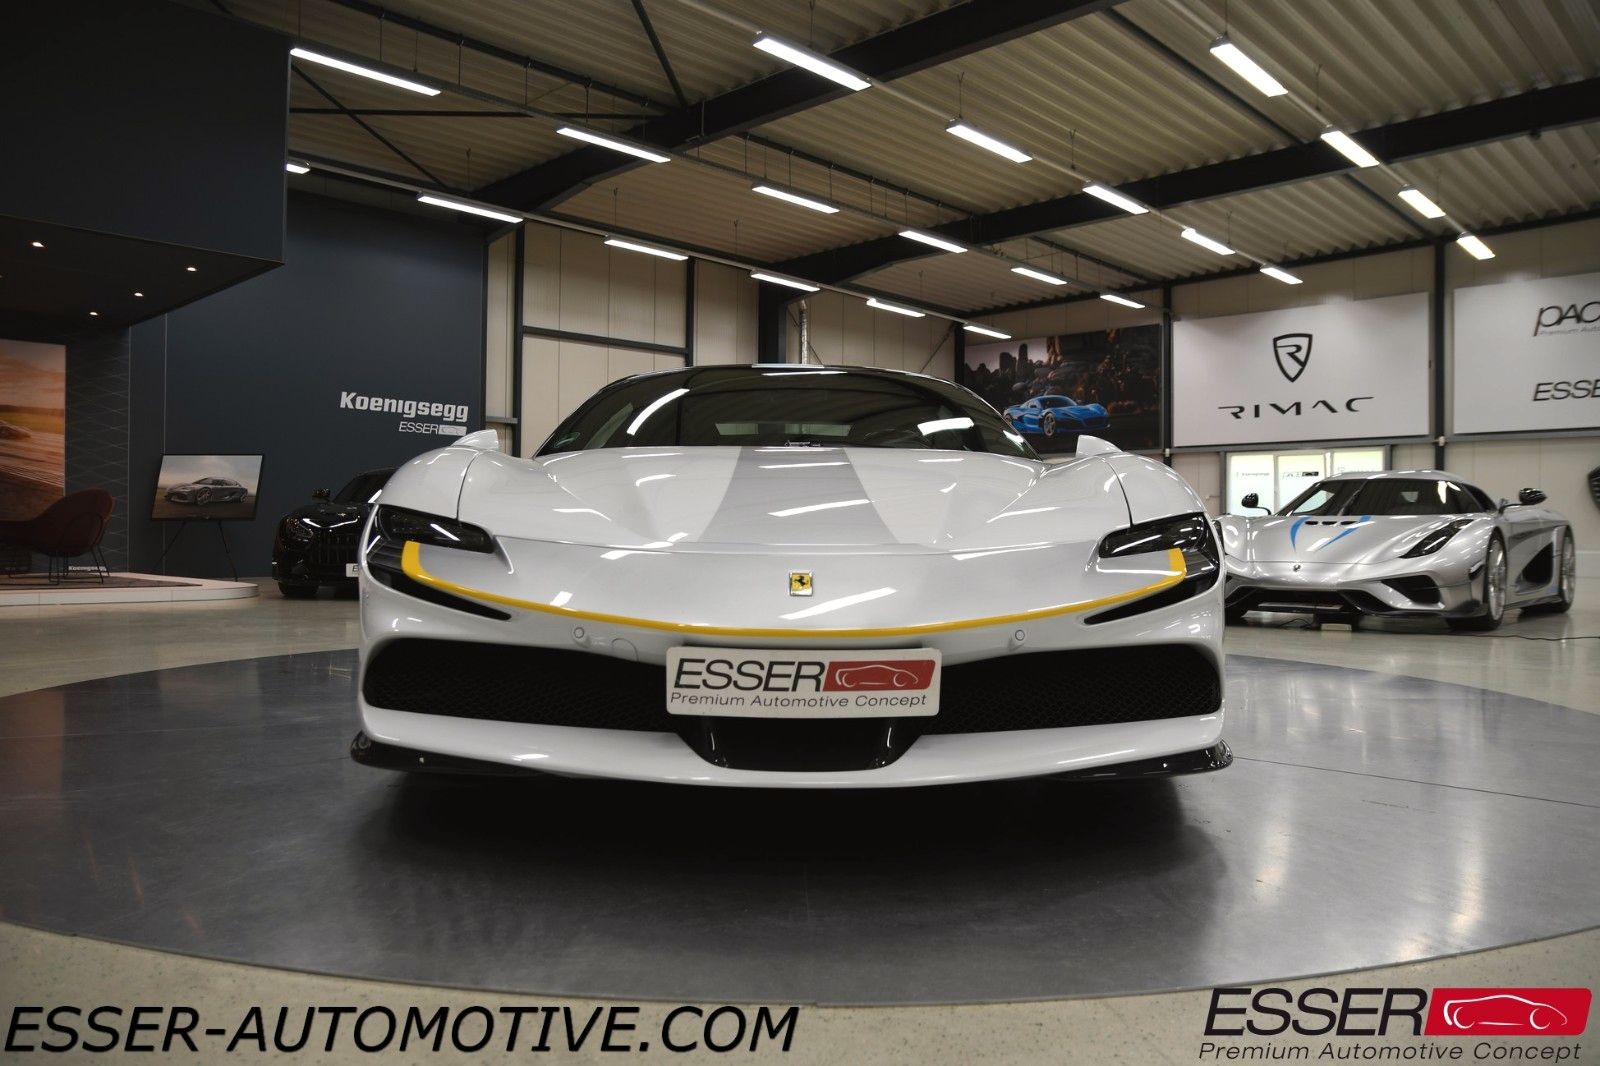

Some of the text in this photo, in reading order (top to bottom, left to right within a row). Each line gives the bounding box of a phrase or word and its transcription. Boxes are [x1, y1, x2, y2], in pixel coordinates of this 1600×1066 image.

[340, 391, 469, 422] Koenigsegg
[1218, 396, 1375, 419] RIMAC
[399, 421, 439, 435] ESSER
[674, 658, 826, 692] ESSER
[670, 692, 927, 709] Premium Automotive Concept
